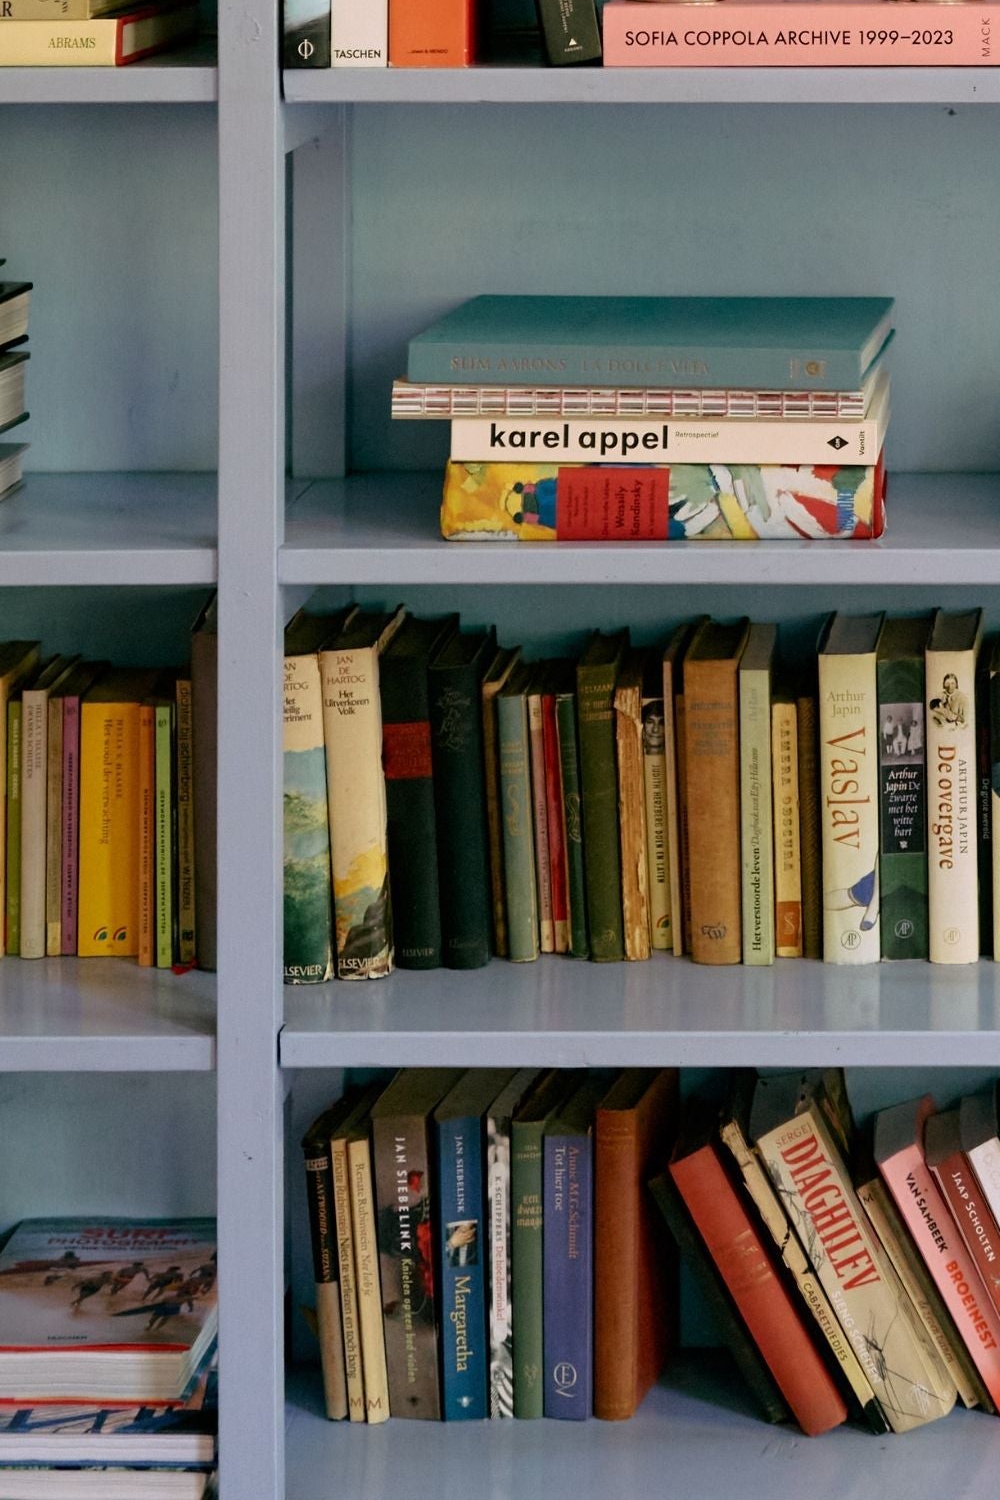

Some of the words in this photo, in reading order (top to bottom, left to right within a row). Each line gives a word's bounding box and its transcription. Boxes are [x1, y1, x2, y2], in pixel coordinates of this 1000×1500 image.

[48, 37, 96, 49] ABRAMS
[624, 30, 679, 46] SOFIA
[684, 30, 767, 46] COPPOLA
[774, 30, 852, 46] ARCHIVE
[981, 17, 991, 57] MACK
[334, 49, 382, 59] TASCHEN
[497, 357, 567, 372] AARONS
[489, 423, 570, 449] karel
[578, 425, 669, 456] appel
[675, 431, 720, 439] Retrospectief
[858, 430, 866, 456] Vantilt
[631, 479, 645, 537] Kandinsky
[326, 673, 367, 686] HARTOG
[324, 697, 371, 708] Uitverkoren
[338, 706, 357, 716] Volk
[888, 769, 919, 780] Arthur
[937, 744, 957, 774] De
[824, 726, 871, 851] Vaslav
[957, 758, 968, 816] ARTHUR
[933, 776, 957, 871] overgave
[958, 818, 969, 855] JAPIN
[395, 1136, 408, 1164] JAN
[774, 1122, 812, 1147] SERGEJ
[396, 1169, 412, 1251] SIEBELINK
[779, 1134, 882, 1292] DIAGHILEV
[951, 1171, 969, 1200] JAAP
[963, 1201, 996, 1263] SCHOLTEN
[916, 1195, 949, 1253] SAMBEEK
[945, 1260, 998, 1351] BROEINEST
[449, 1274, 474, 1373] Margaretha
[803, 1281, 849, 1363] CABARETLIEDJES
